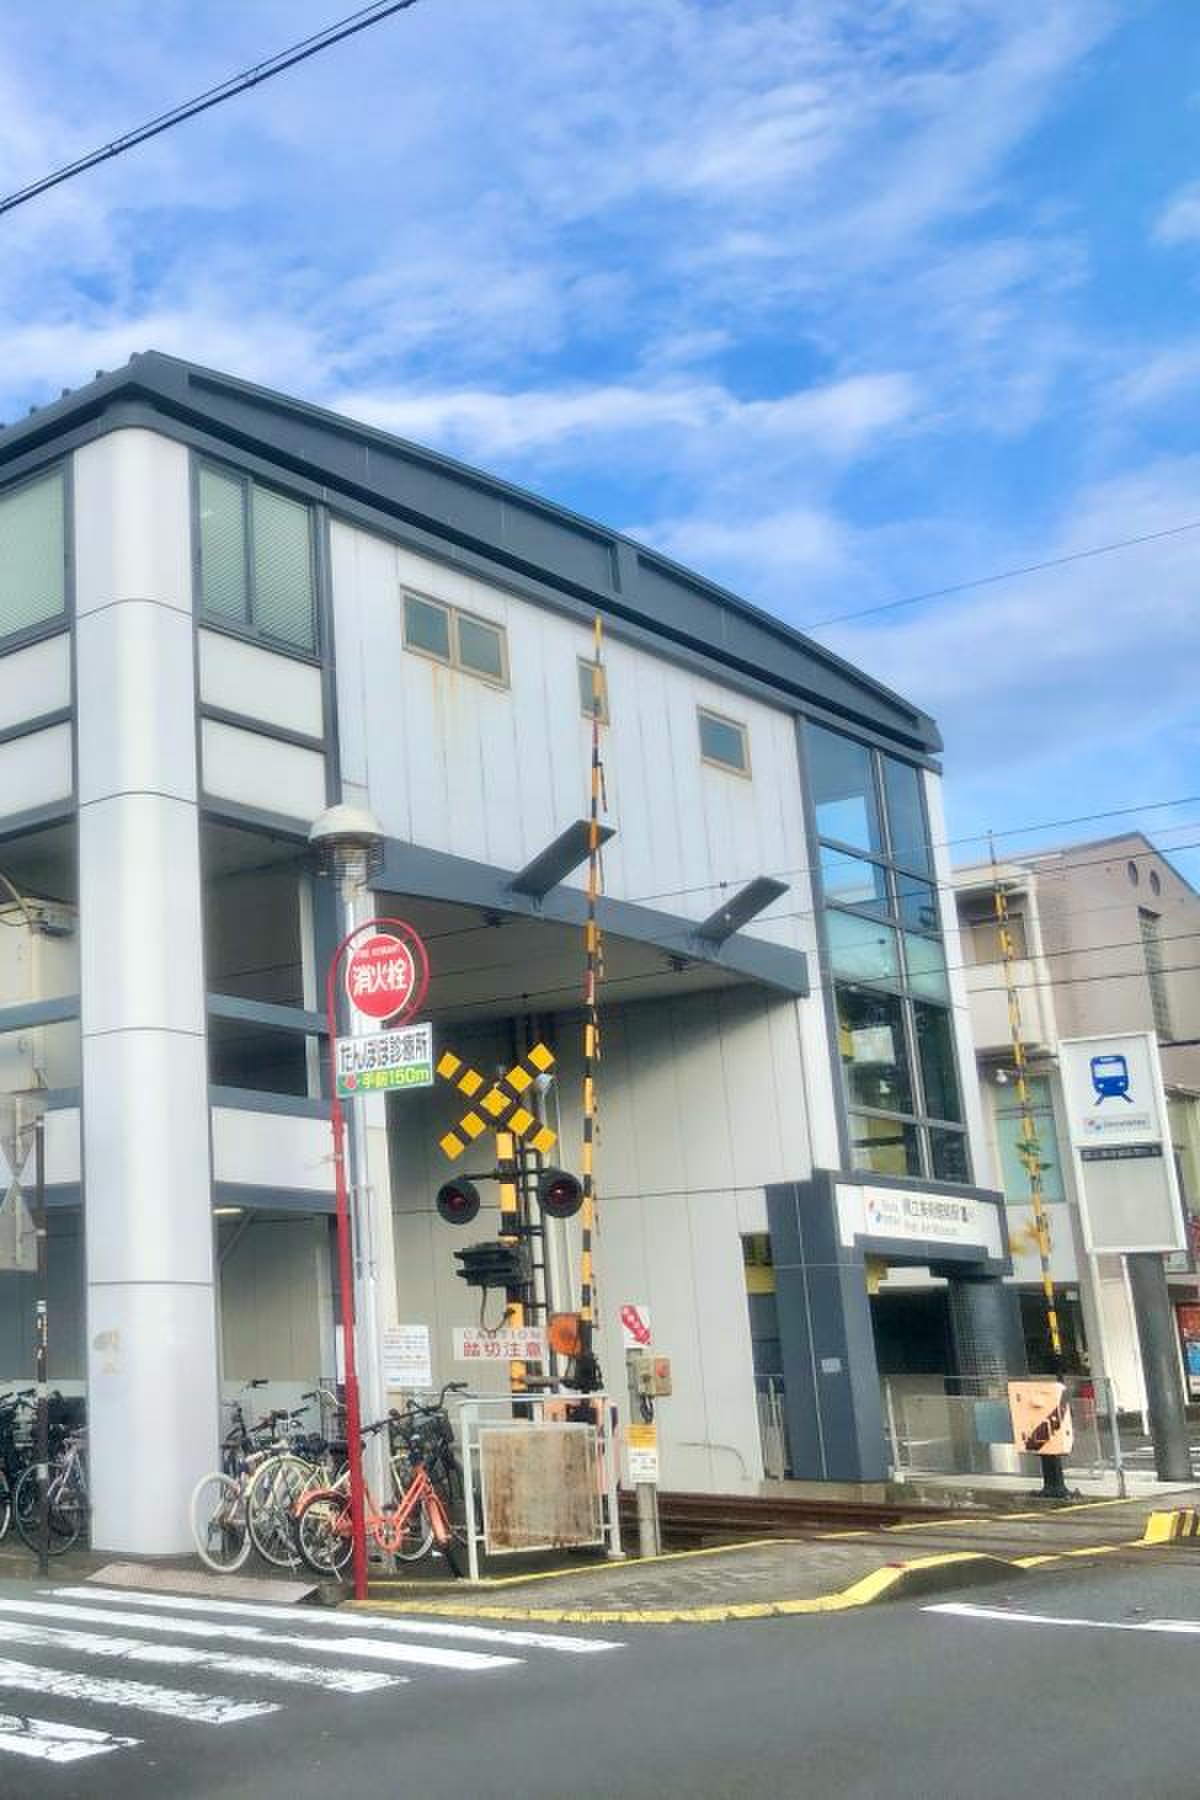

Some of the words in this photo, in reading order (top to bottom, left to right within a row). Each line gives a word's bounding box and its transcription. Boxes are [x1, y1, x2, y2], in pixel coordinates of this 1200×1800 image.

[352, 958, 408, 997] 消火栓
[463, 1328, 542, 1340] CAUTION
[463, 1342, 542, 1358] 踏切注意
